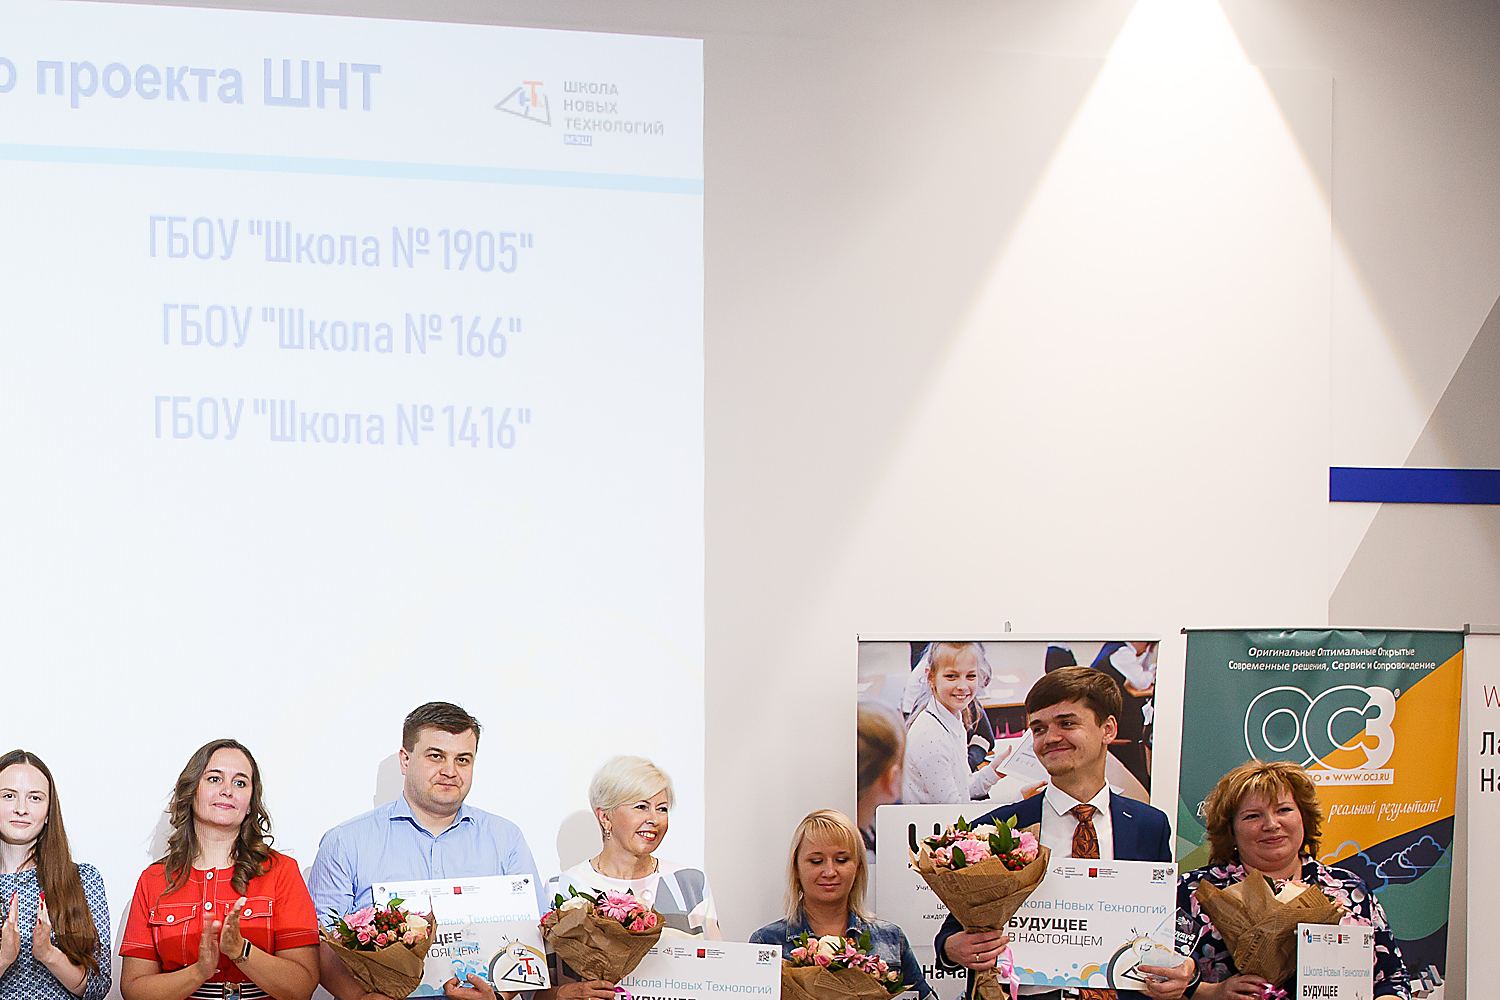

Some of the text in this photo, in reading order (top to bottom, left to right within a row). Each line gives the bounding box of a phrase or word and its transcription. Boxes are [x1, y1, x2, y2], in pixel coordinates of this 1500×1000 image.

[36, 57, 244, 109] проекта
[262, 58, 382, 112] ШНТ
[564, 81, 619, 96] ШКОЛА
[563, 99, 618, 114] НОВЫХ
[564, 117, 665, 136] ТЕХНОЛОГИЙ
[148, 215, 534, 274] ГБОУ "Школа № 1905"
[161, 303, 523, 359] ГБОУ "Школа № 166"
[152, 395, 532, 451] ГБОУ "Школа № 1416"
[1248, 648, 1415, 658] Оригинальные Оптимальные Открытые
[1228, 661, 1436, 671] Современные решения, Сервис Сопровождение
[1327, 797, 1442, 822] реальный результат!
[1054, 899, 1167, 914] Новых Технологий
[1008, 916, 1088, 932] БУДУЩЕЕ
[1018, 932, 1103, 947] НАСТОЯЩЕМ
[1303, 966, 1370, 977] Школа Новых Технологий
[621, 976, 772, 994] Школа Новых Технологий
[1303, 985, 1338, 999] БУДУЩЕЕ
